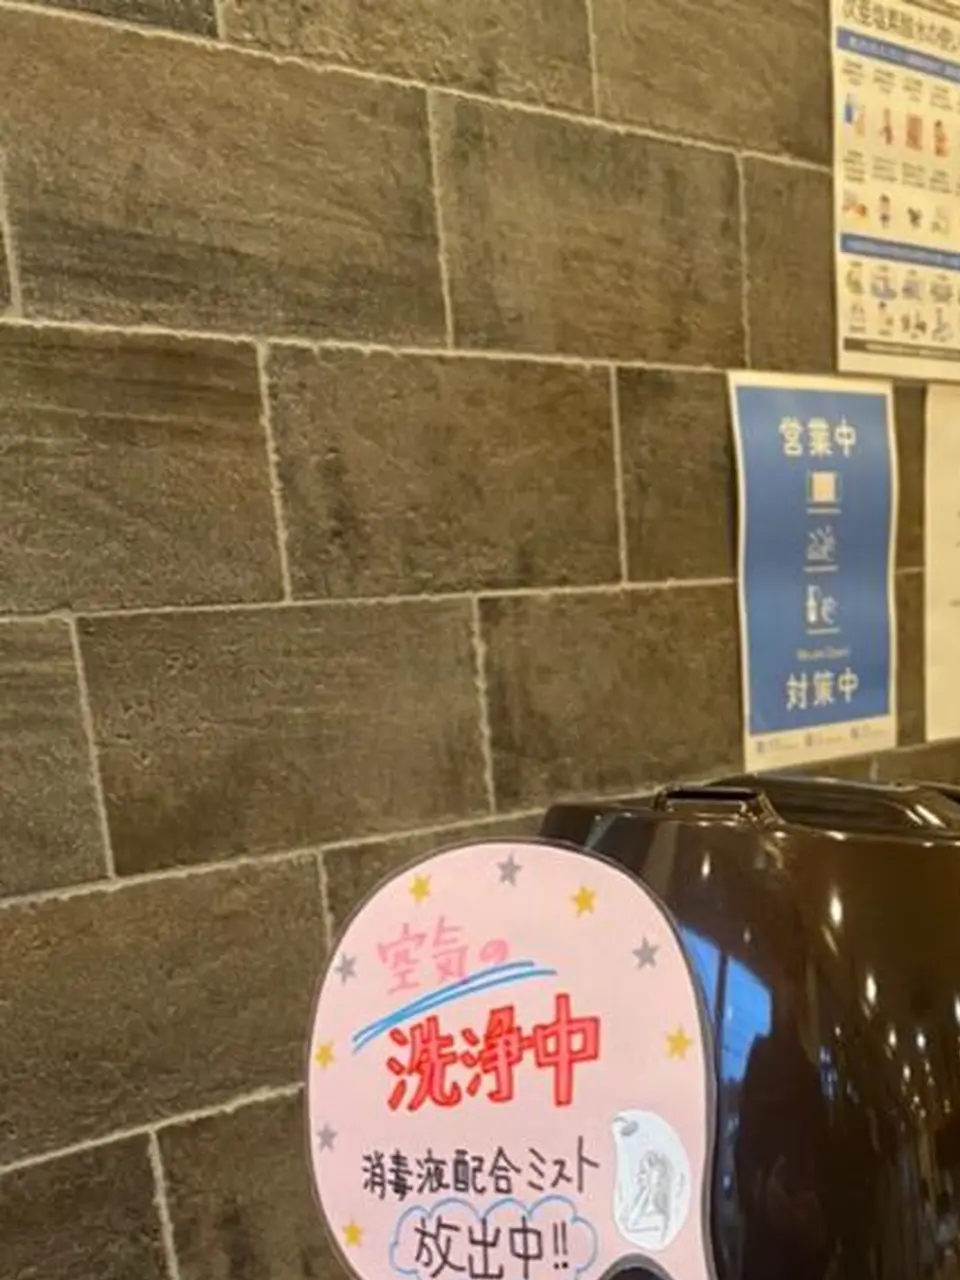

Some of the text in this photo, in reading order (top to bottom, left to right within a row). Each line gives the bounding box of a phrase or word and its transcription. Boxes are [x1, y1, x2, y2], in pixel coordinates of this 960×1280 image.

[779, 415, 857, 458] 営業中
[786, 667, 860, 712] 対策中
[377, 915, 509, 996] 空気の
[385, 992, 600, 1113] 洗浄中
[360, 1134, 601, 1202] 消毒液配合ミスト
